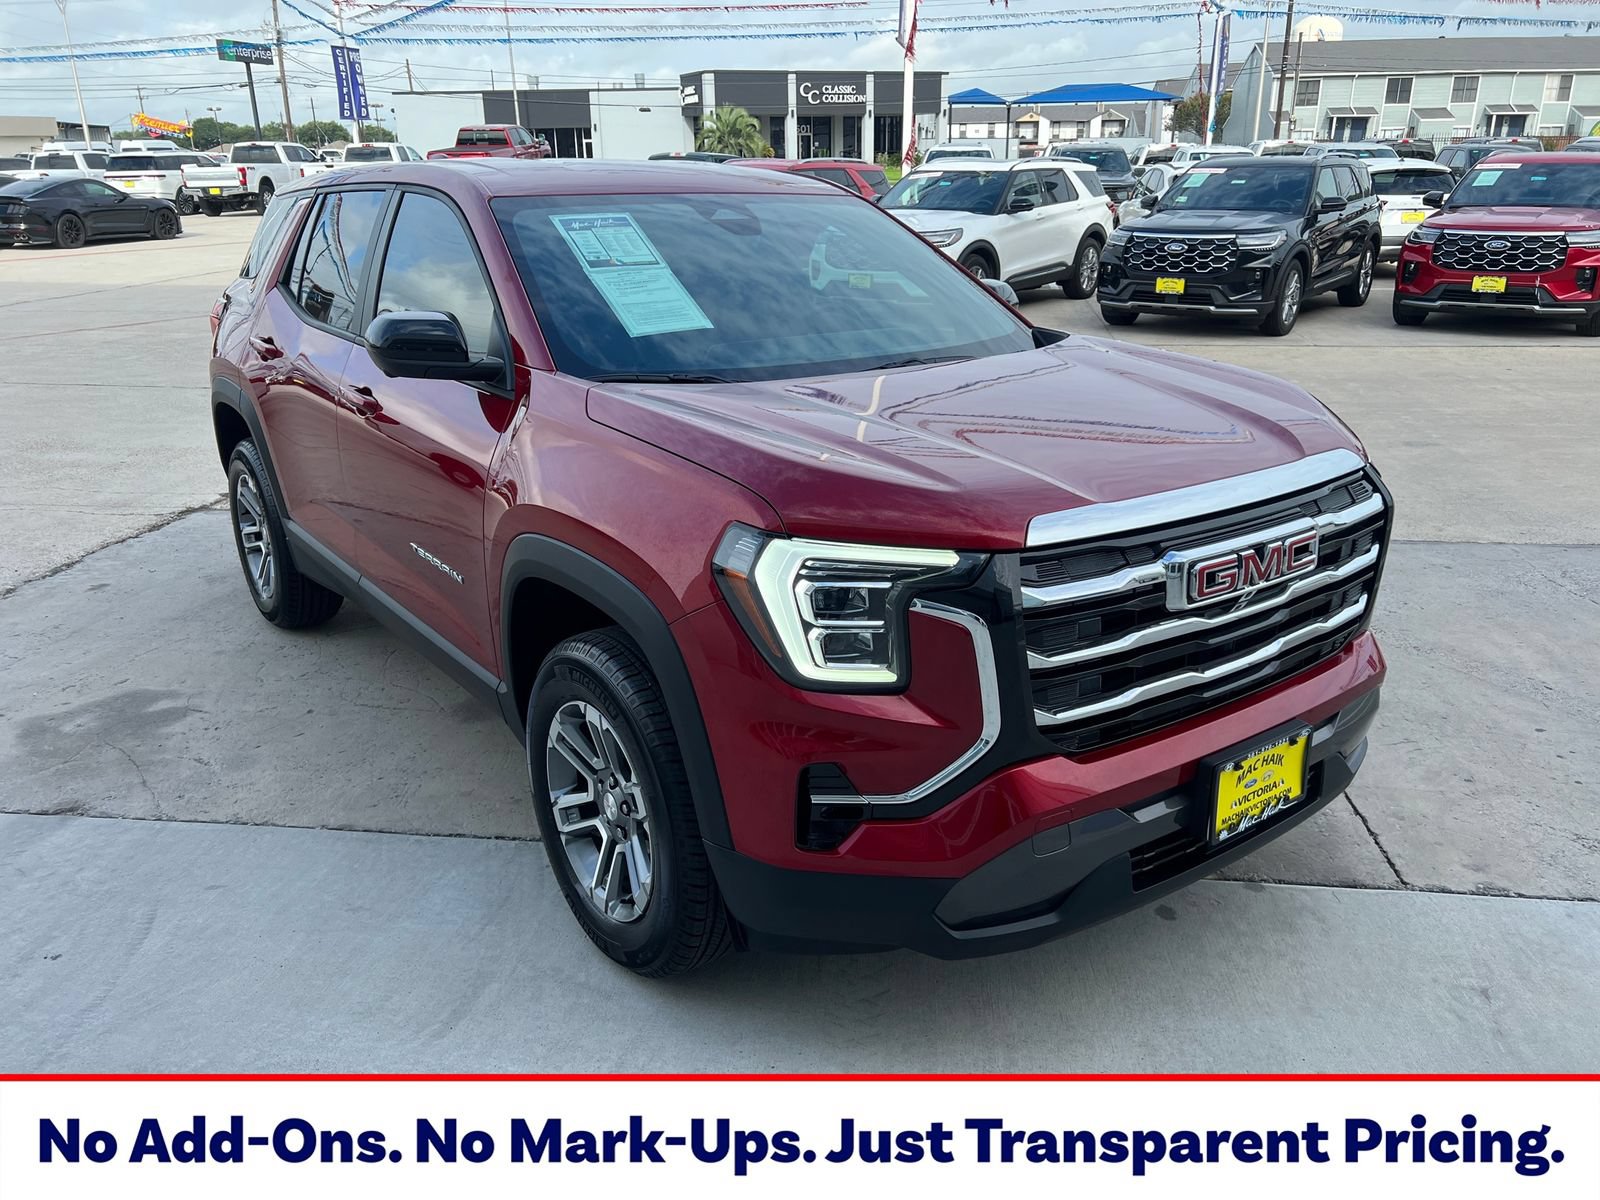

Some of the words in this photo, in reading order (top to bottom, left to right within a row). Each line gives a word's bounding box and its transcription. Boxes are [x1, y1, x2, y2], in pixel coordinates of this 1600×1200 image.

[226, 46, 272, 60] enterprise
[335, 49, 351, 117] CERTIFIED
[355, 63, 367, 117] OWNED
[822, 85, 856, 94] CLASSIC
[822, 94, 866, 103] COLLISION
[410, 542, 463, 585] TERRAIN
[1190, 530, 1318, 600] GMC
[1235, 758, 1260, 788] MAC
[1260, 753, 1285, 768] HAIK
[1238, 780, 1278, 807] VICTORIA
